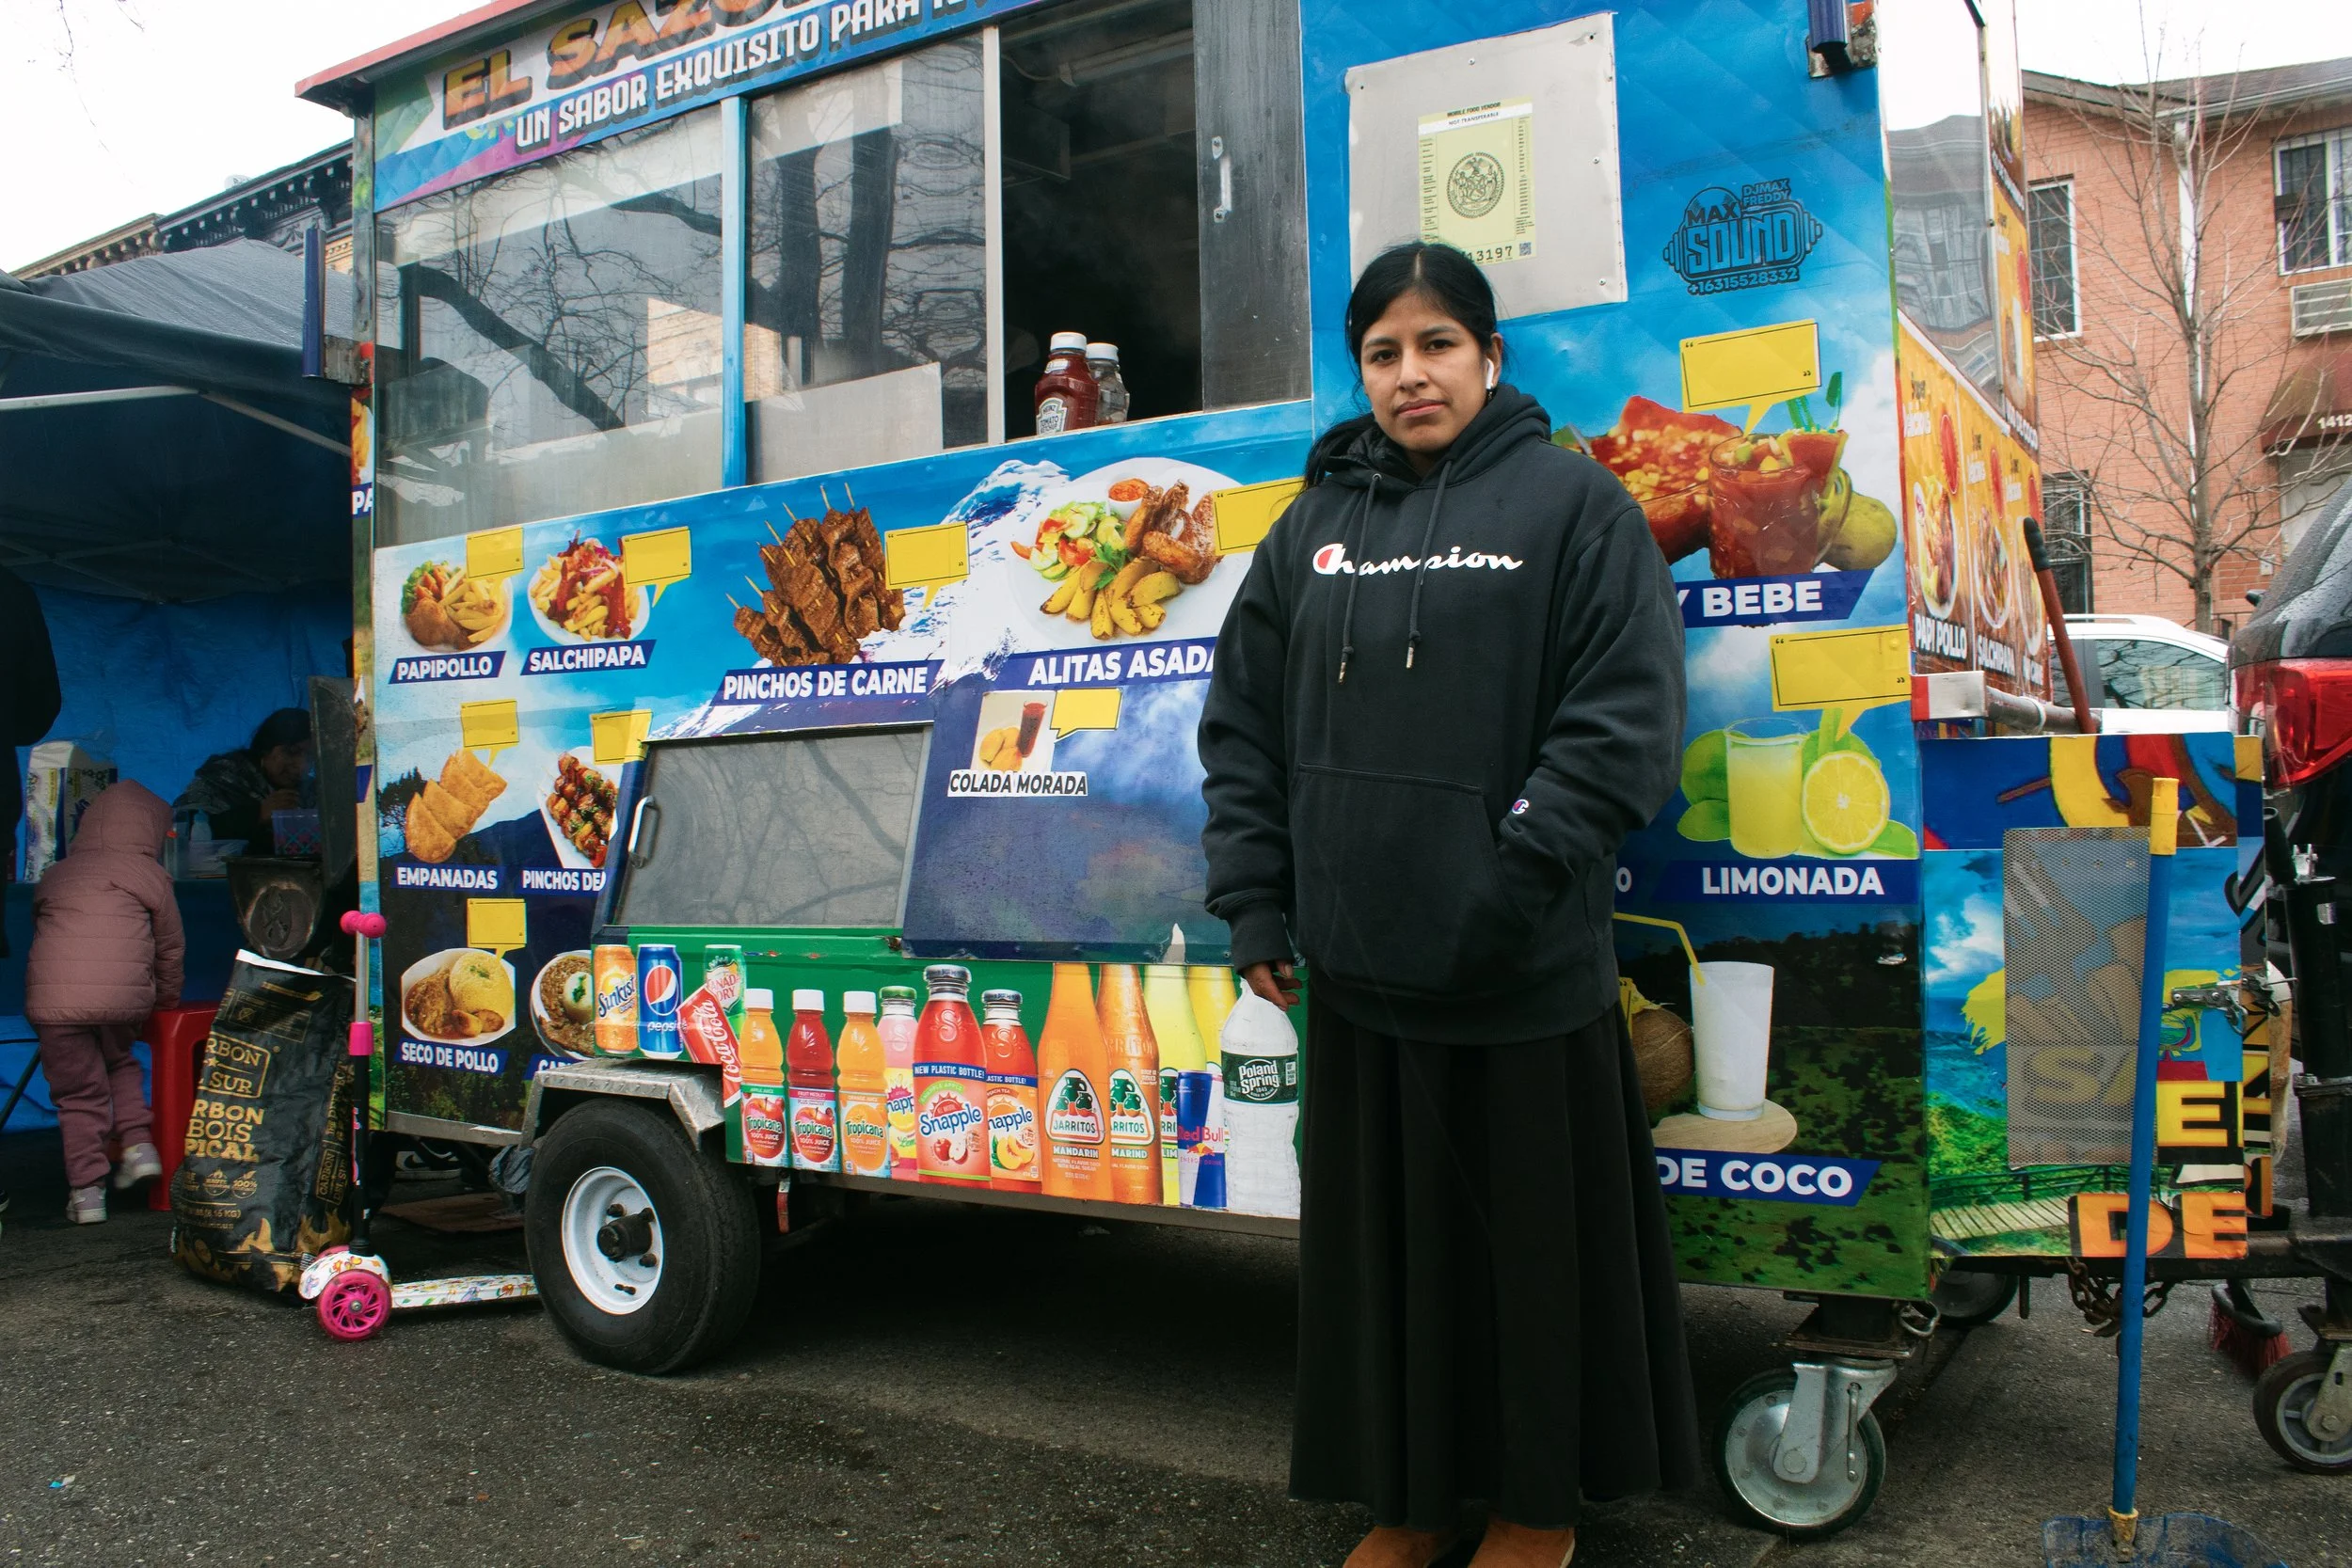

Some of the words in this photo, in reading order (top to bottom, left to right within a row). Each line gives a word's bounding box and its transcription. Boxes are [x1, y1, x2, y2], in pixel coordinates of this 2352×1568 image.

[444, 49, 532, 129] EL
[517, 106, 552, 147] UN
[559, 73, 647, 135] SABOR
[657, 14, 819, 102] EXQUISITO
[1447, 109, 1465, 118] MOBILE
[1466, 105, 1480, 114] FOOD
[1481, 102, 1501, 111] VENDOR
[1743, 191, 1788, 207] FREDDY
[1688, 202, 1739, 225] MAX
[1462, 245, 1513, 262] 13197
[1686, 211, 1796, 275] SOUND
[1702, 580, 1823, 617] BEBE
[1936, 621, 1968, 659] POLLO
[396, 656, 494, 681] PAPIPOLLO
[529, 645, 646, 673] SALCHIPAPA
[1027, 651, 1122, 686] ALITAS
[723, 671, 814, 700] PINCHOS
[817, 671, 848, 697] DE
[851, 667, 929, 696] CARNE
[950, 773, 1012, 793] COLADA
[1016, 774, 1087, 795] MORADA
[396, 866, 498, 890] EMPANADAS
[522, 869, 580, 891] PINCHOS
[1702, 865, 1885, 895] LIMONADA
[597, 974, 637, 1018] Sunkist
[401, 1041, 433, 1064] SECO
[436, 1048, 453, 1067] DE
[456, 1051, 500, 1073] POLLO
[210, 1071, 253, 1094] SUR
[914, 1065, 930, 1074] NEW
[930, 1065, 957, 1075] PLASTIC
[959, 1067, 985, 1079] BOTTLE!
[1238, 1060, 1279, 1081] Poland
[1240, 1074, 1280, 1095] Spring
[191, 1099, 264, 1125] RBON
[919, 1103, 983, 1136] Snapple
[988, 1106, 1033, 1132] napple
[185, 1118, 253, 1143] BOIS
[746, 1116, 783, 1134] Tropicana
[795, 1119, 834, 1139] Tropicana
[845, 1120, 884, 1138] Tropicana
[1053, 1120, 1096, 1133] JARRITOS
[1112, 1121, 1145, 1133] RRITOS
[1177, 1124, 1200, 1142] Red
[1202, 1126, 1223, 1142] Bull
[184, 1137, 260, 1164] PICAL
[1053, 1146, 1099, 1158] MANDARIN
[1111, 1148, 1148, 1159] MARIND
[1656, 1155, 1708, 1188] DE
[1720, 1159, 1853, 1197] COCO
